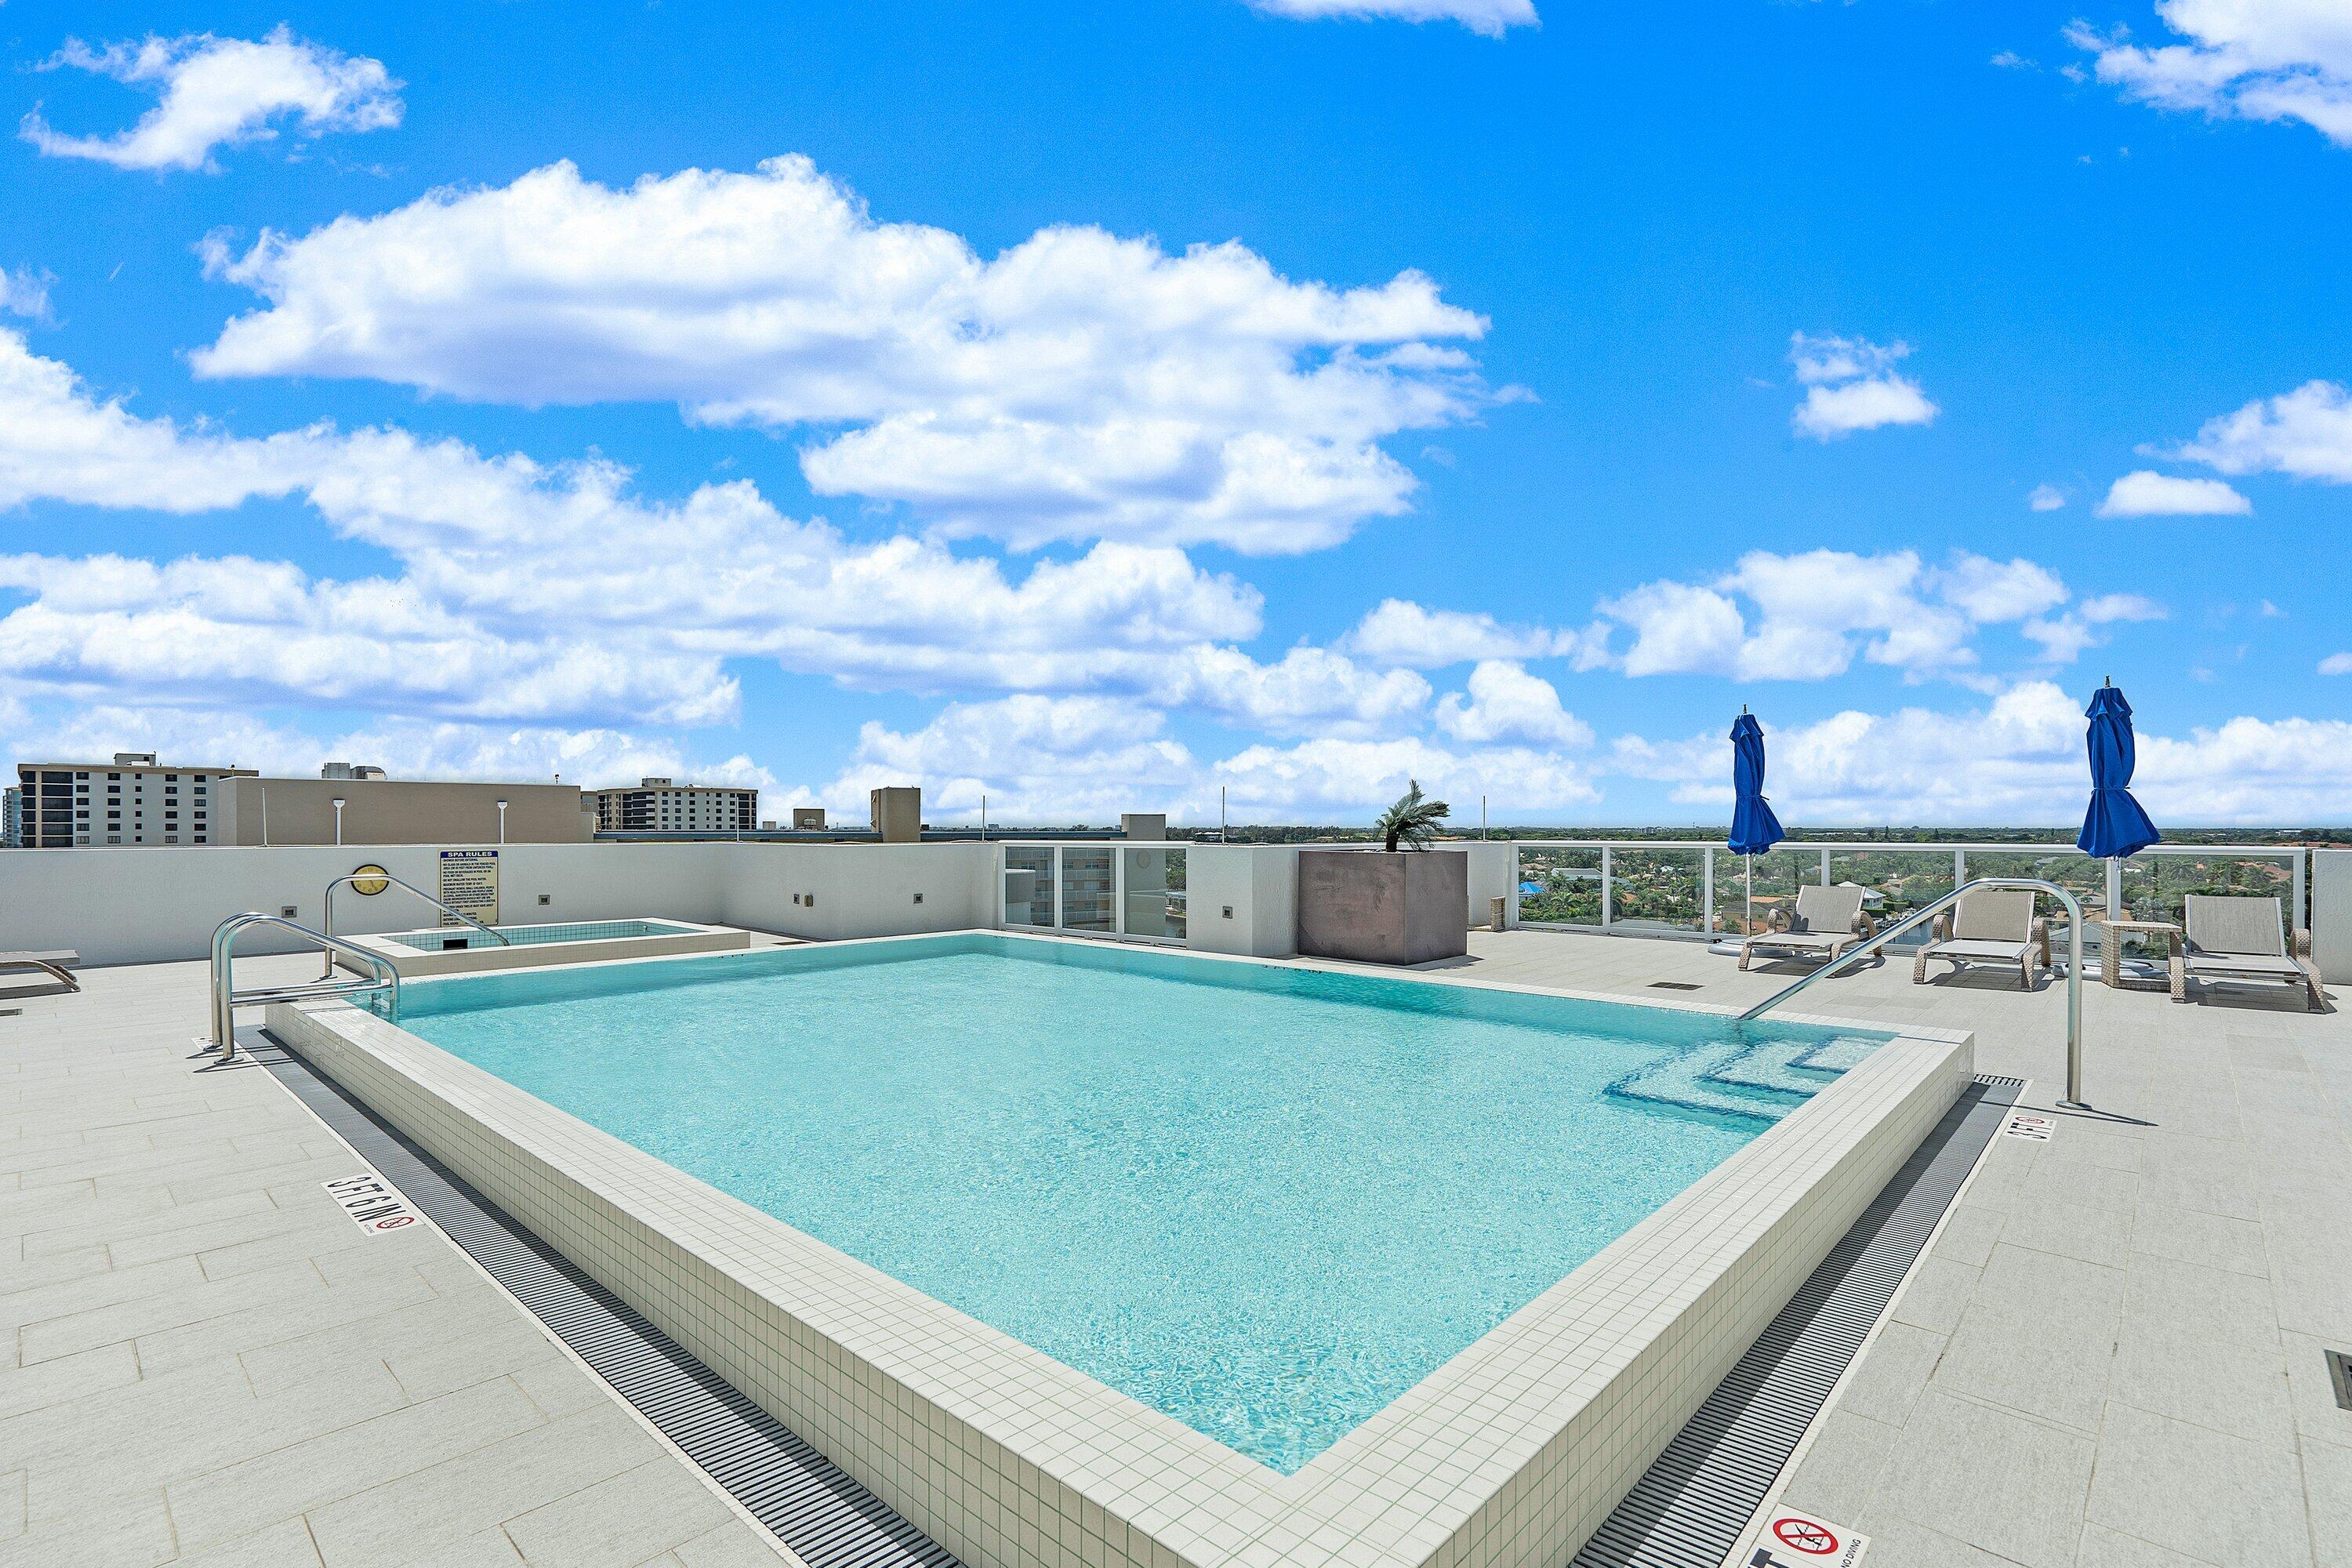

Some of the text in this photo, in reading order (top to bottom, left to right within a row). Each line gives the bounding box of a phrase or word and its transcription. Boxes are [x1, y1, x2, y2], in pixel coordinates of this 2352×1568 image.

[2010, 1122, 2051, 1134] FT
[327, 1176, 406, 1222] 3 FT 6 IN
[1846, 1539, 1861, 1559] DIVING
